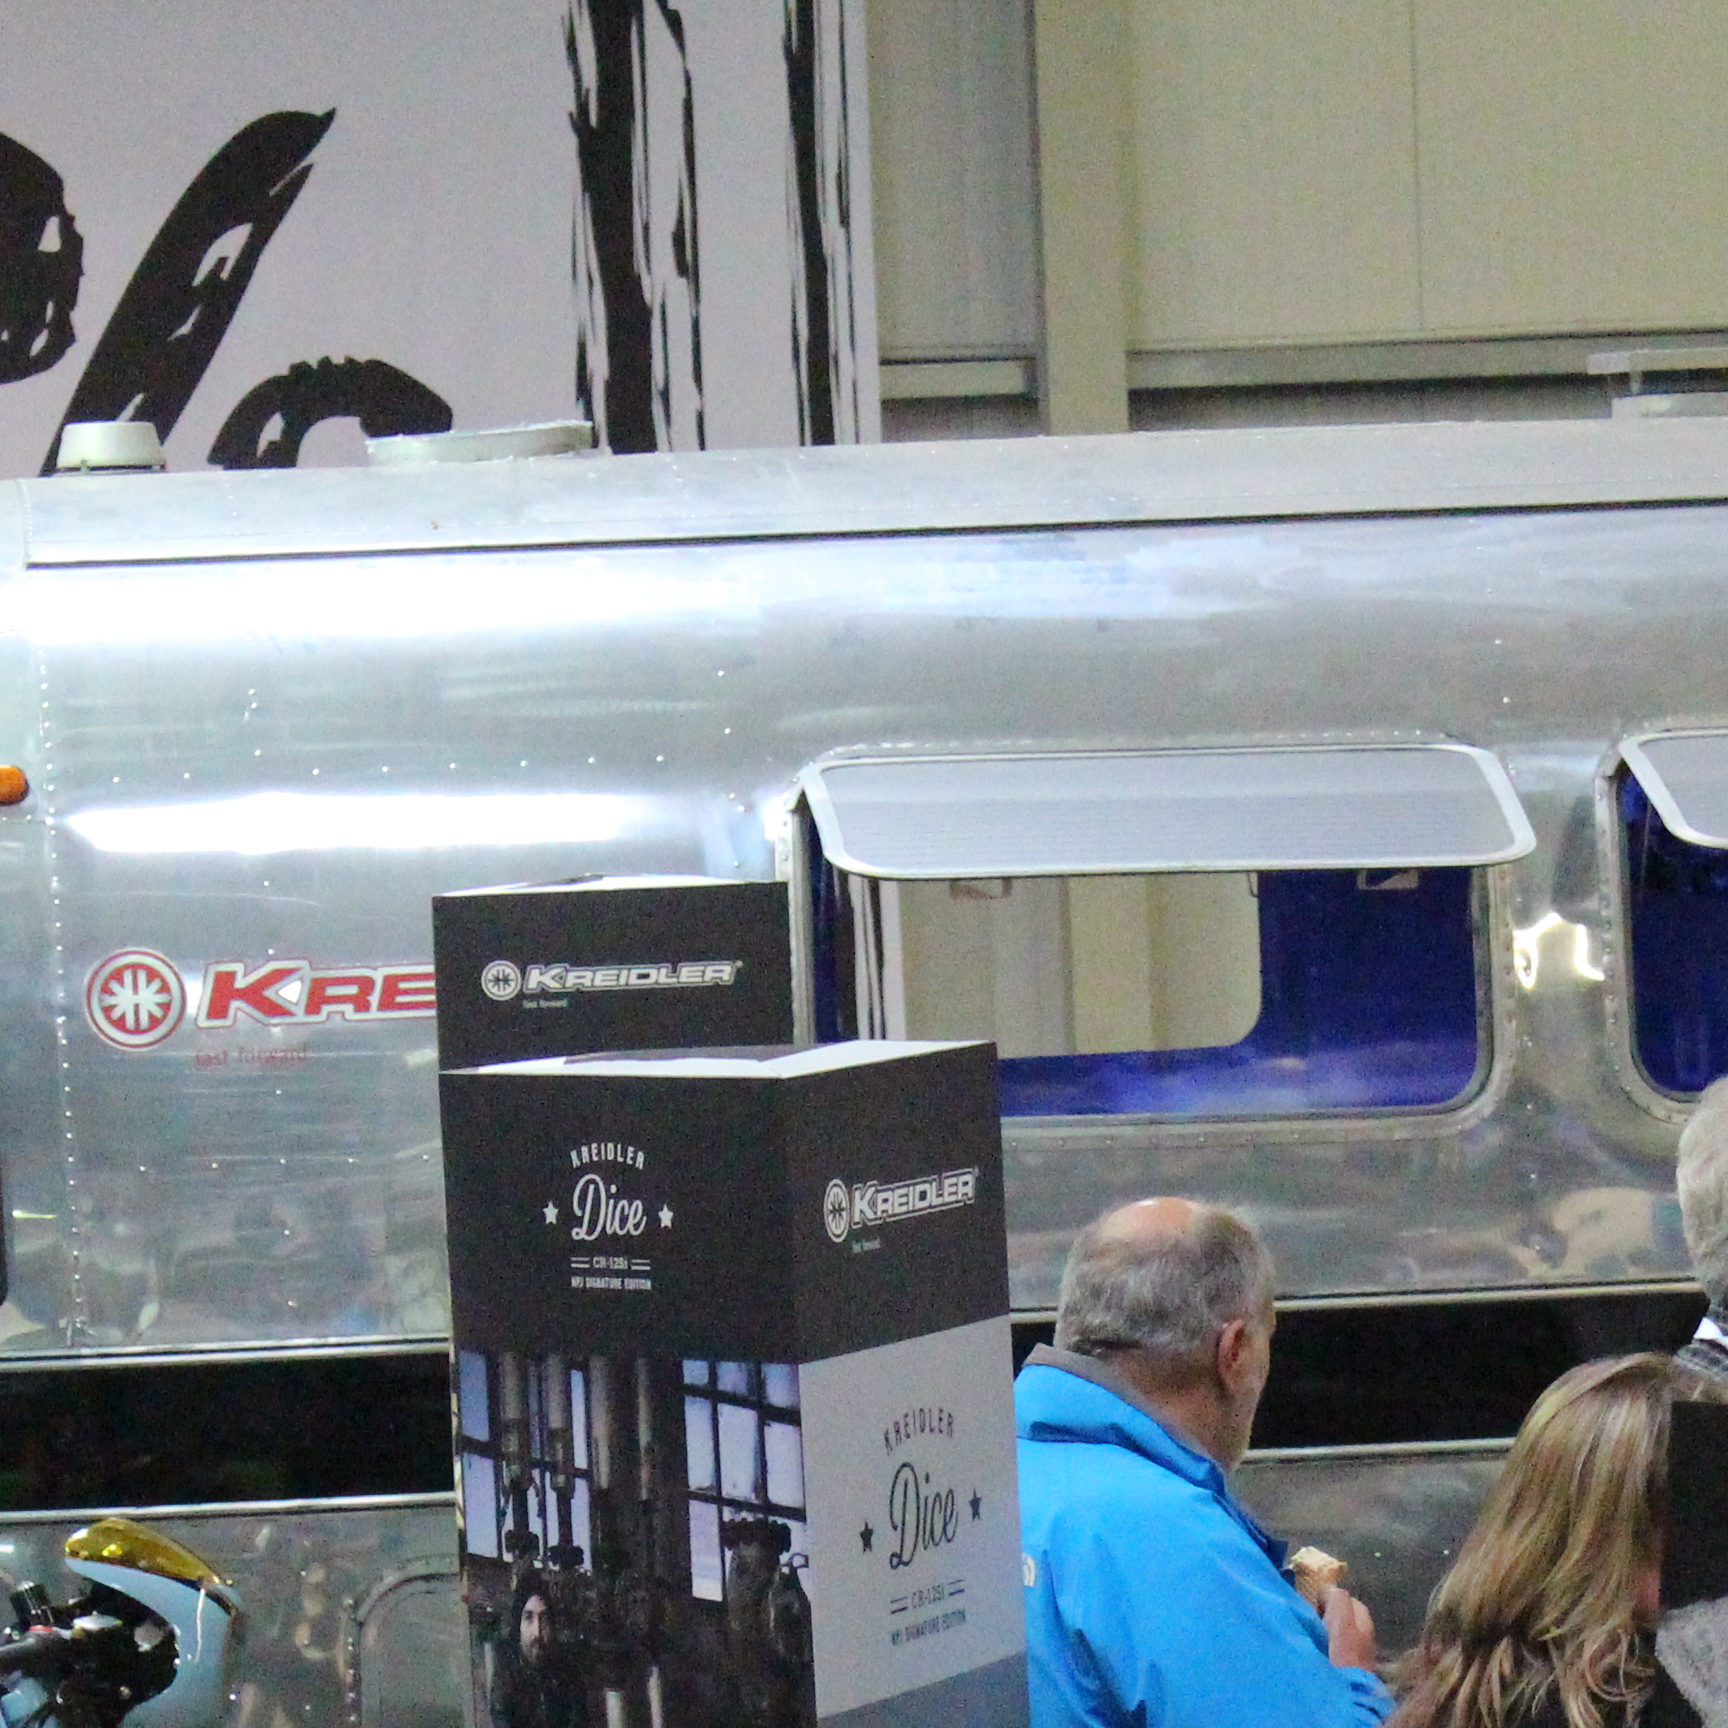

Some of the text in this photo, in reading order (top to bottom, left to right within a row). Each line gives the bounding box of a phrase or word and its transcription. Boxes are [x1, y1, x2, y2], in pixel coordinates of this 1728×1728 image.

[524, 961, 736, 993] KREIDLER
[570, 1142, 645, 1170] KREIDLER
[571, 1173, 647, 1241] Dice
[851, 1168, 975, 1229] KREIDLER
[883, 1407, 954, 1456] KREIDLER
[889, 1462, 958, 1570] Dice
